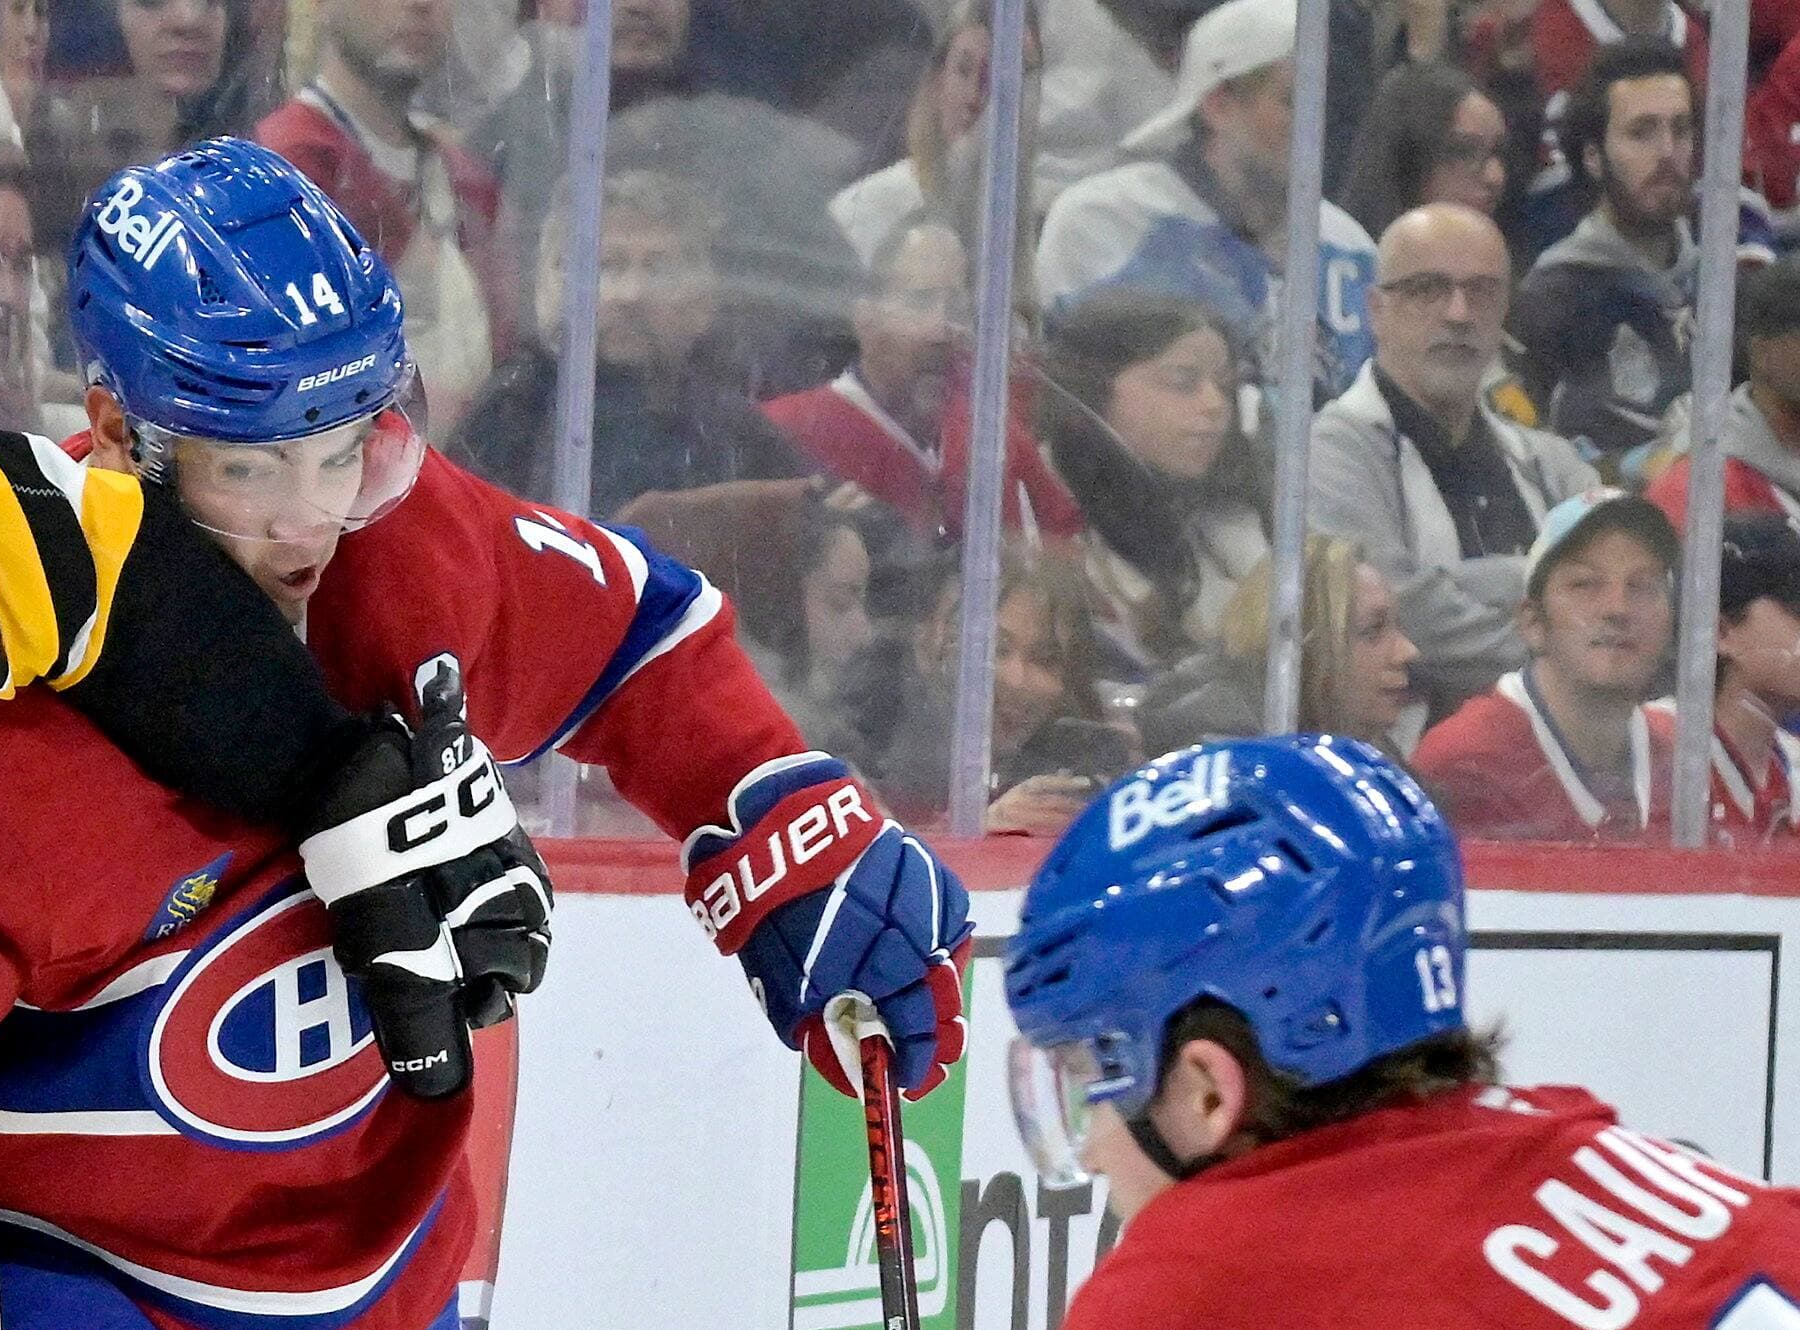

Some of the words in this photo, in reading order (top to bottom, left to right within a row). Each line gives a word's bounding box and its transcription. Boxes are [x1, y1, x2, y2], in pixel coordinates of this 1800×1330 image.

[100, 177, 185, 271] Bell
[286, 272, 344, 326] 14
[297, 353, 376, 393] BAUER
[512, 508, 609, 588] 1
[441, 734, 468, 775] 87
[387, 752, 502, 854] CC
[1109, 750, 1231, 851] Bell
[690, 784, 873, 942] BAUER
[1415, 944, 1457, 1013] 13
[391, 1049, 449, 1072] CCM
